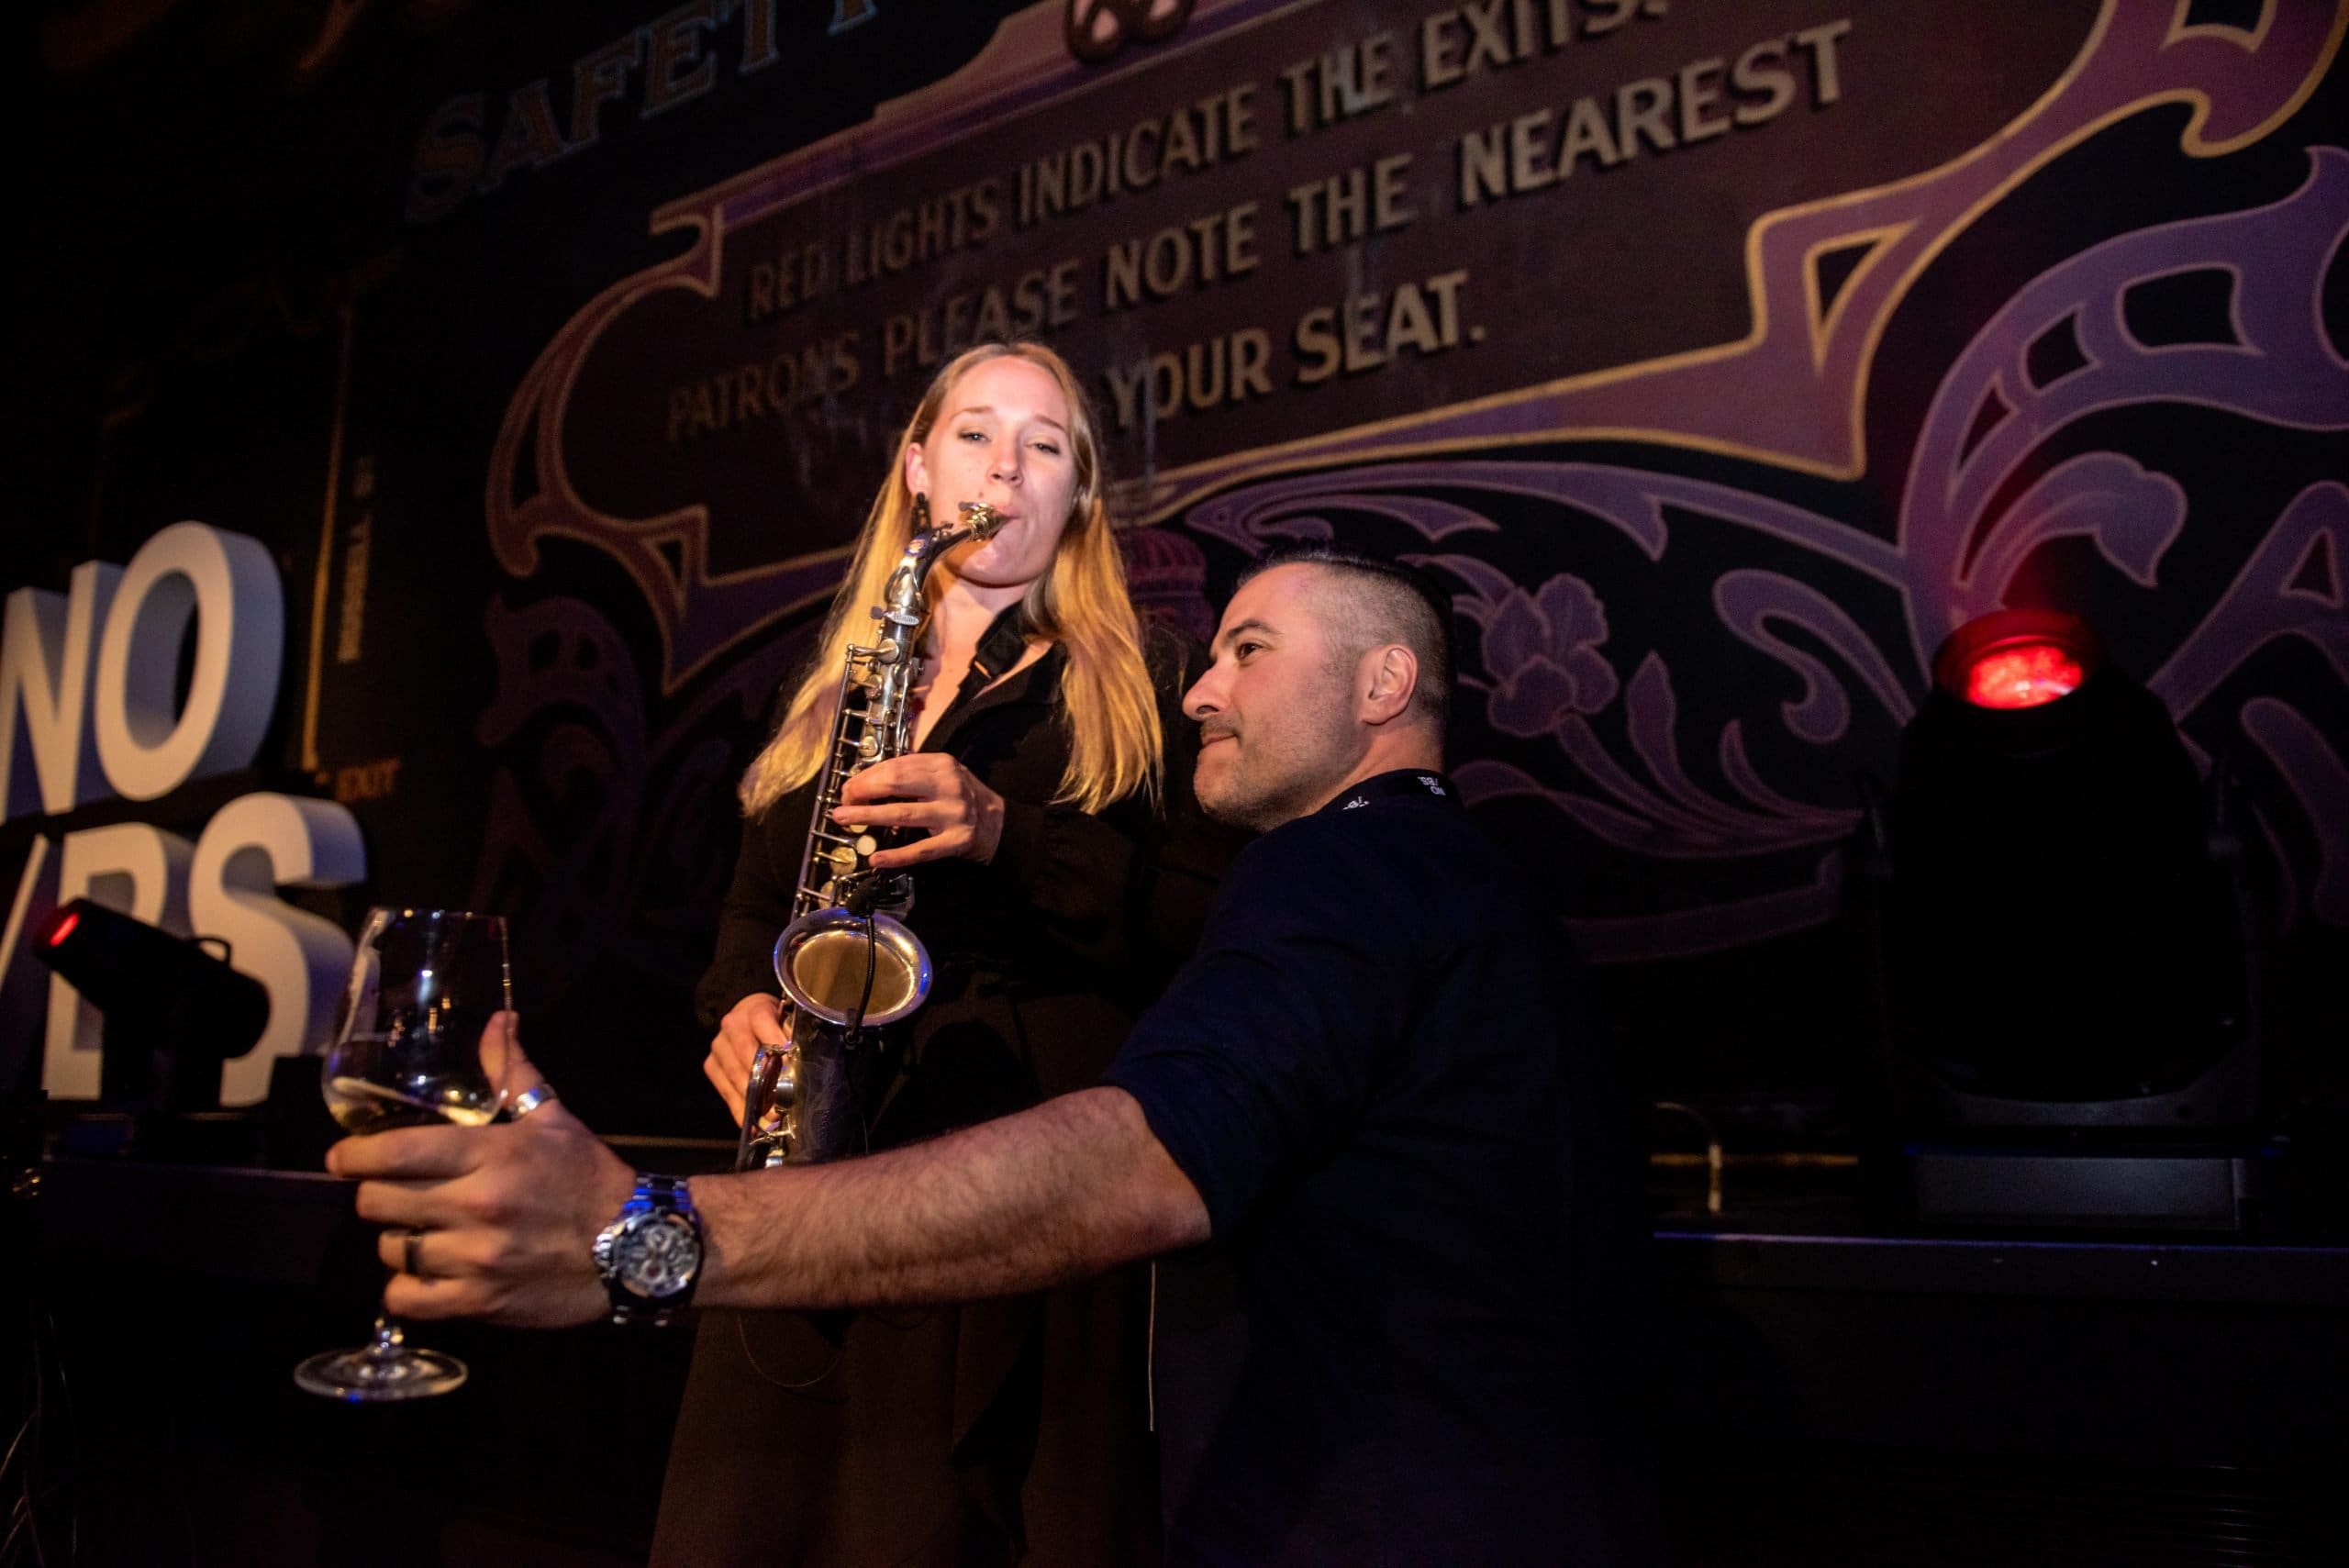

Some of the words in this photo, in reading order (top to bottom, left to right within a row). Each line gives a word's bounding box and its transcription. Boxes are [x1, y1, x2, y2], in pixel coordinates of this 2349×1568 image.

[663, 331, 861, 441] PATRONS
[883, 260, 1082, 375] PLEASE
[1105, 202, 1261, 309] NOTE
[1286, 153, 1415, 255] THE
[1461, 18, 1853, 207] NEAREST
[748, 243, 825, 322] RED
[844, 183, 999, 284] LIGHTS
[1019, 84, 1261, 225] INDICATE
[1284, 31, 1396, 135] THE
[1104, 328, 1274, 431] YOUR
[1294, 270, 1486, 386] SEAT.
